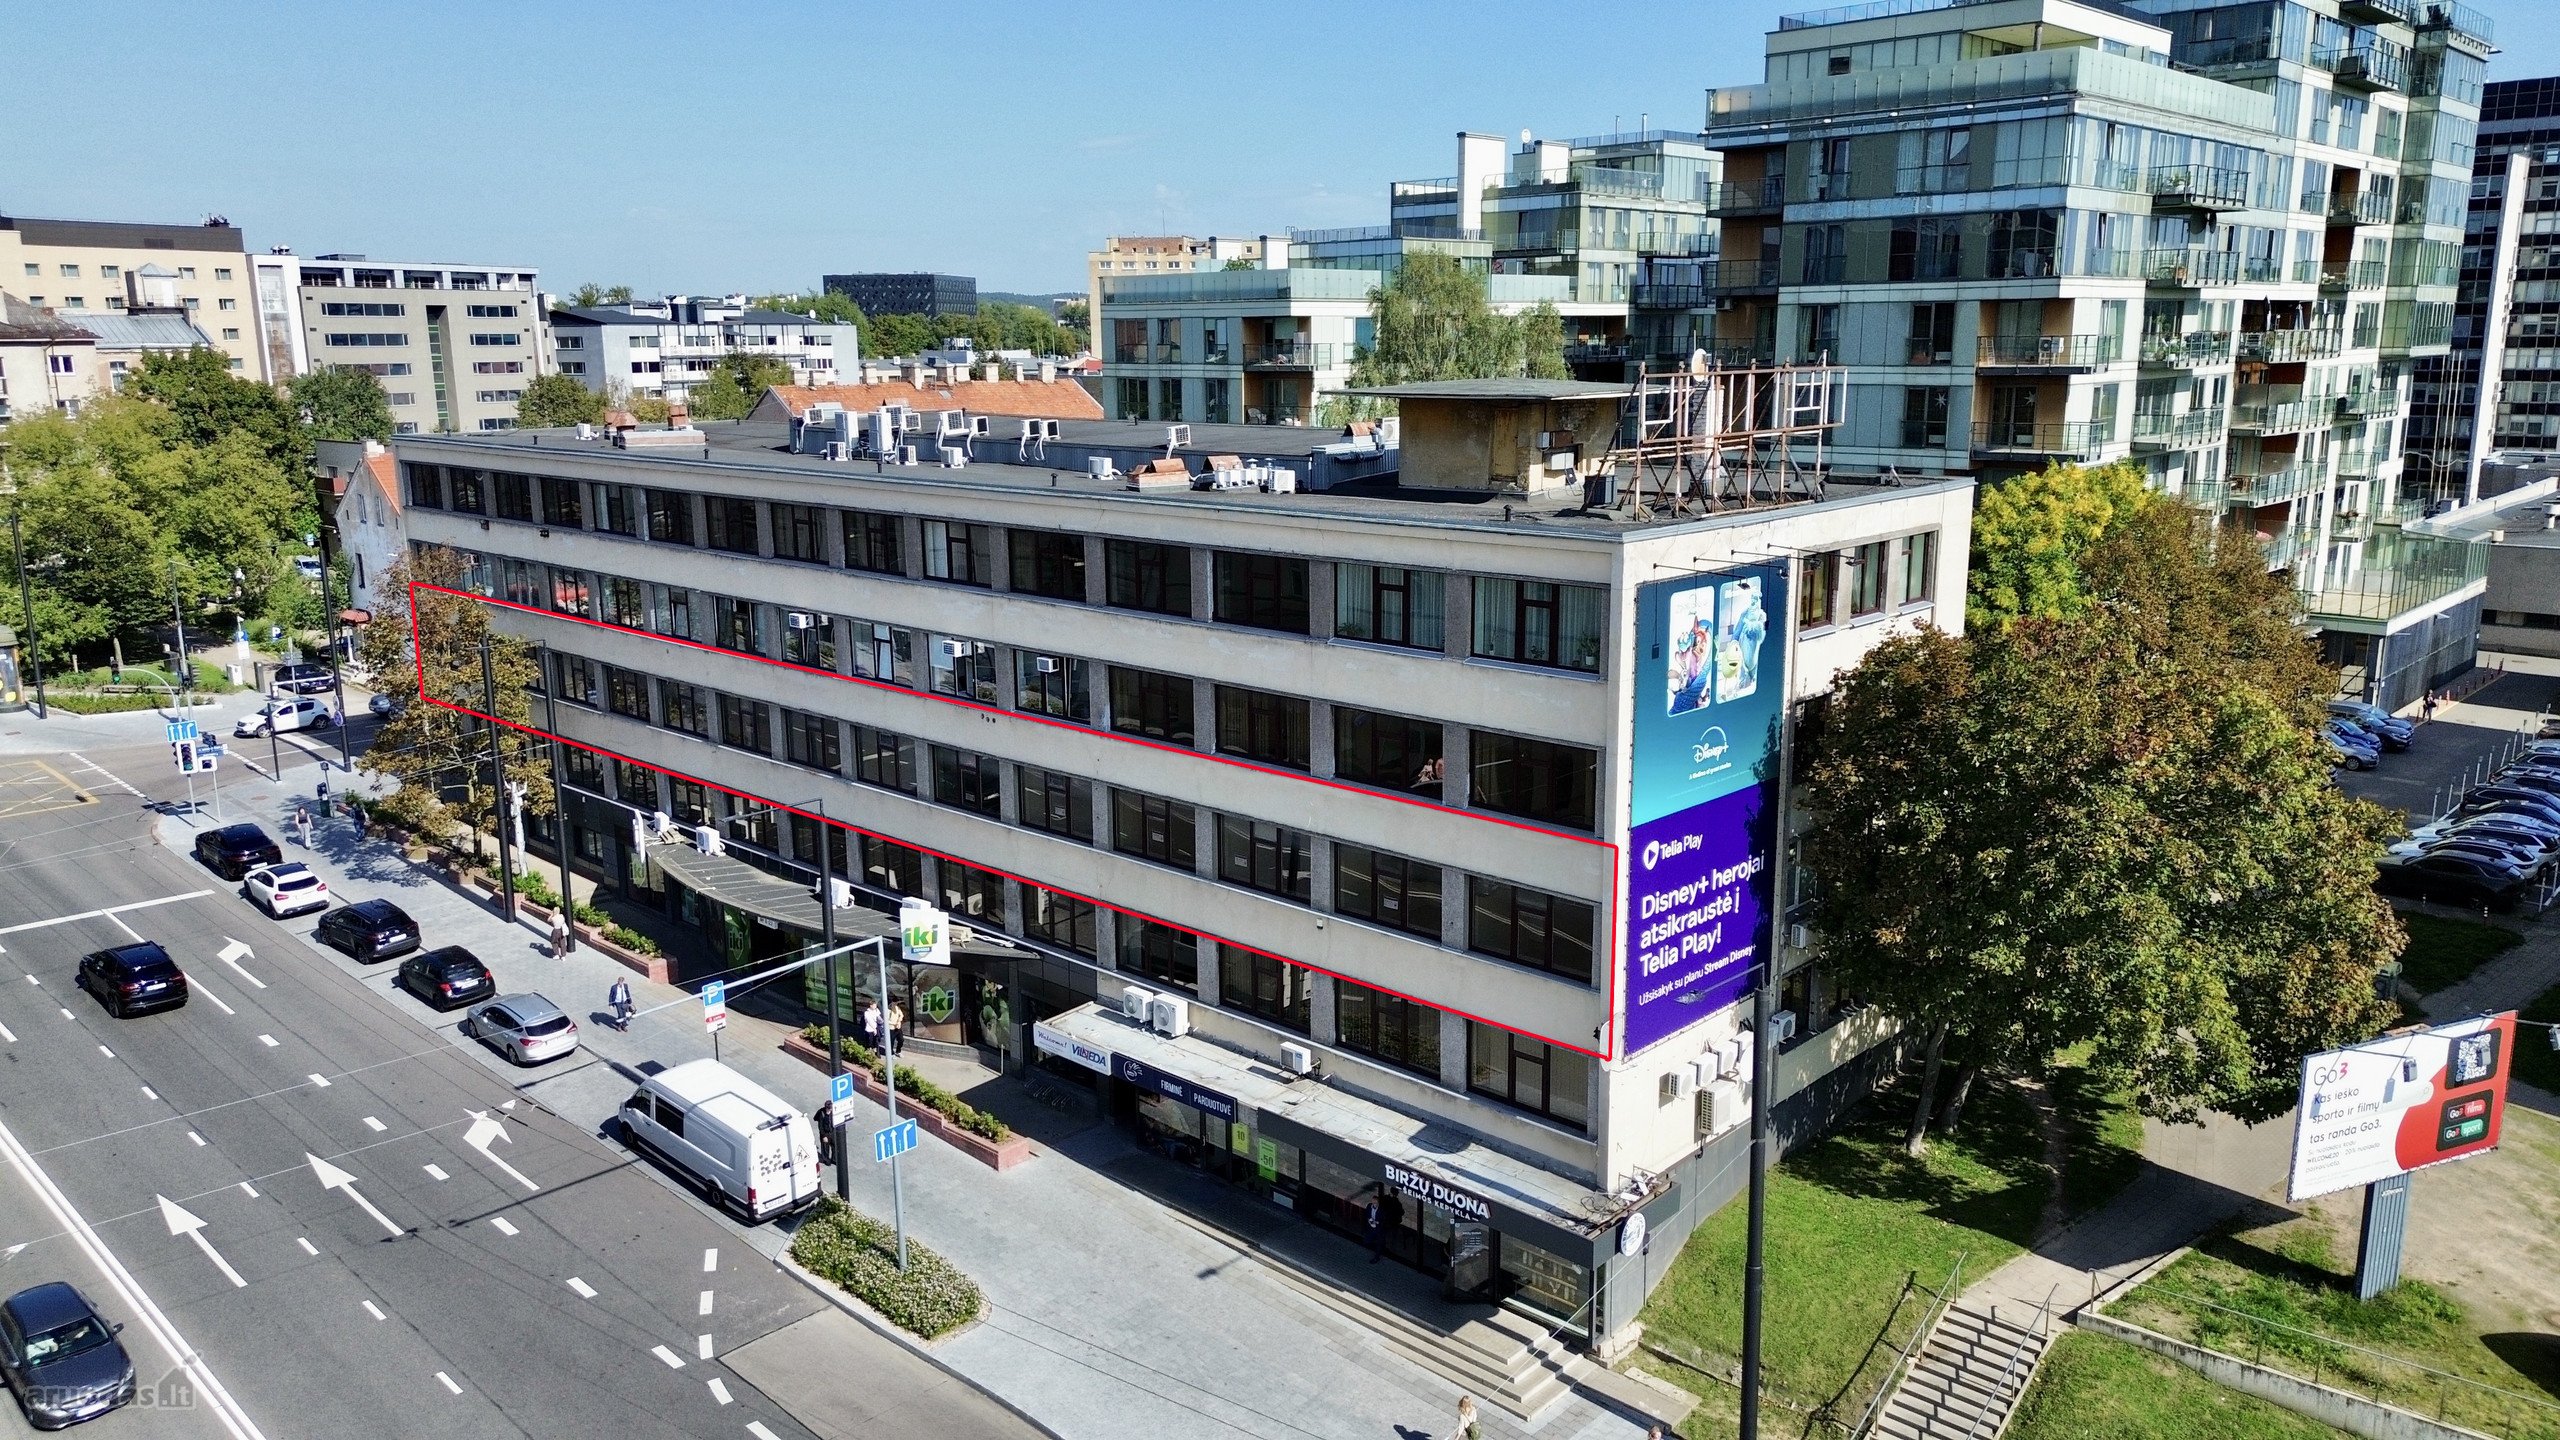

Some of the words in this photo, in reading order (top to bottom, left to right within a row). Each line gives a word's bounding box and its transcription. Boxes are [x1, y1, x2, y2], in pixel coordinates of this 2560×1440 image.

[1660, 840, 1683, 860] Telia
[1684, 834, 1703, 852] Play
[1641, 875, 1709, 920] Disney+
[1711, 849, 1765, 891] herojai
[1640, 890, 1733, 950] atsikraustė
[1734, 886, 1740, 914] į
[904, 924, 938, 947] iki
[1639, 944, 1679, 977] Telia
[1682, 922, 1722, 960] Play!
[1638, 981, 1674, 1006] Užsisakyk
[1674, 977, 1683, 987] su
[1684, 968, 1704, 987] planu
[1704, 956, 1729, 975] Stream
[1729, 943, 1757, 963] Disney+
[922, 991, 955, 1012] iki
[2313, 1062, 2348, 1086] Go3
[836, 1078, 849, 1099] P
[1160, 1079, 1183, 1097] FIRMINĖ
[2313, 1093, 2332, 1105] Kas
[2334, 1087, 2360, 1100] ieško
[1193, 1092, 1232, 1116] PARDUOTUVĖ
[2312, 1108, 2344, 1124] sporto
[2347, 1106, 2354, 1116] ir
[2357, 1100, 2381, 1114] filmų
[2309, 1132, 2325, 1144] tas
[2328, 1123, 2357, 1140] randa
[2360, 1118, 2382, 1132] Go3.
[1385, 1163, 1430, 1196] BIRŽŲ
[1432, 1182, 1491, 1220] DUONA
[1402, 1187, 1432, 1205] ŠEIMOS
[1434, 1200, 1471, 1221] KEPYKLA
